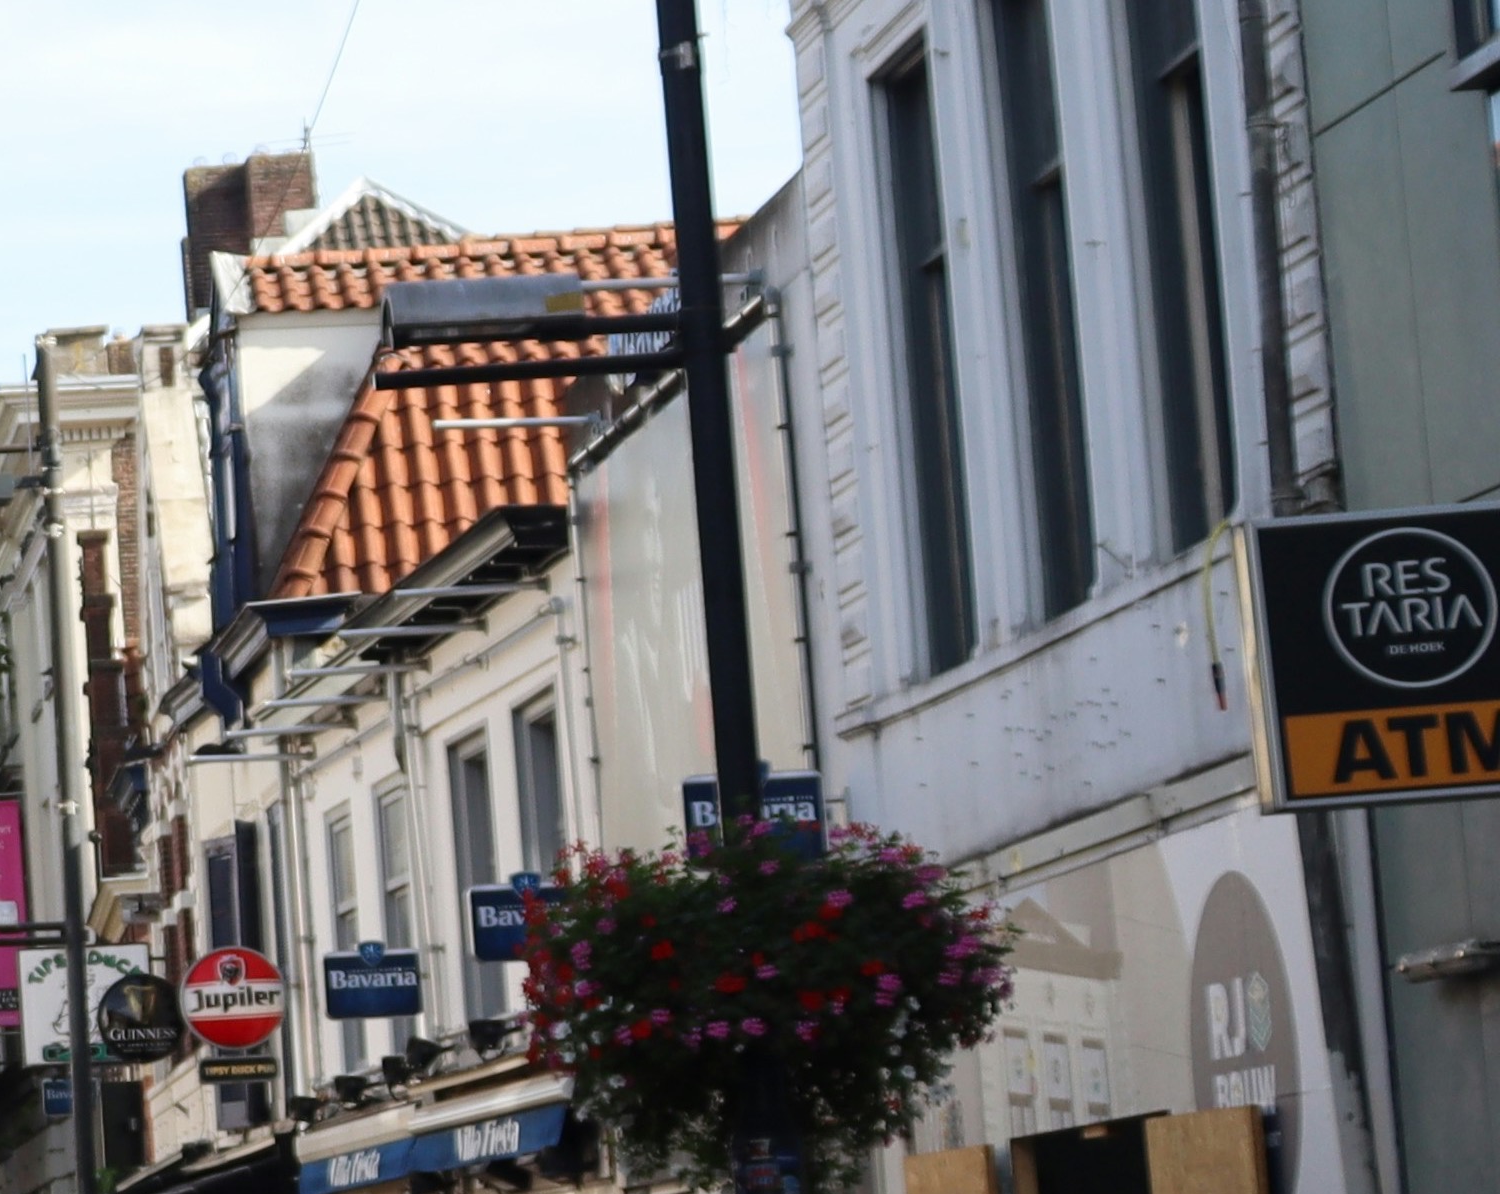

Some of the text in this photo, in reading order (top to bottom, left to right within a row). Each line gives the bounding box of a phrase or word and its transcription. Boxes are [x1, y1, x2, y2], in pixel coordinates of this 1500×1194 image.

[1361, 557, 1451, 598] RES
[1340, 594, 1483, 637] TARIA
[1388, 641, 1446, 656] DE HOEK
[1334, 710, 1500, 783] ATM
[27, 953, 68, 985] TIPS
[330, 969, 418, 990] Bavaria
[190, 987, 281, 1013] Jupiler
[109, 1028, 178, 1041] GUINNESS
[1206, 977, 1247, 1060] RJ
[455, 1118, 521, 1161] Villa Fiesta
